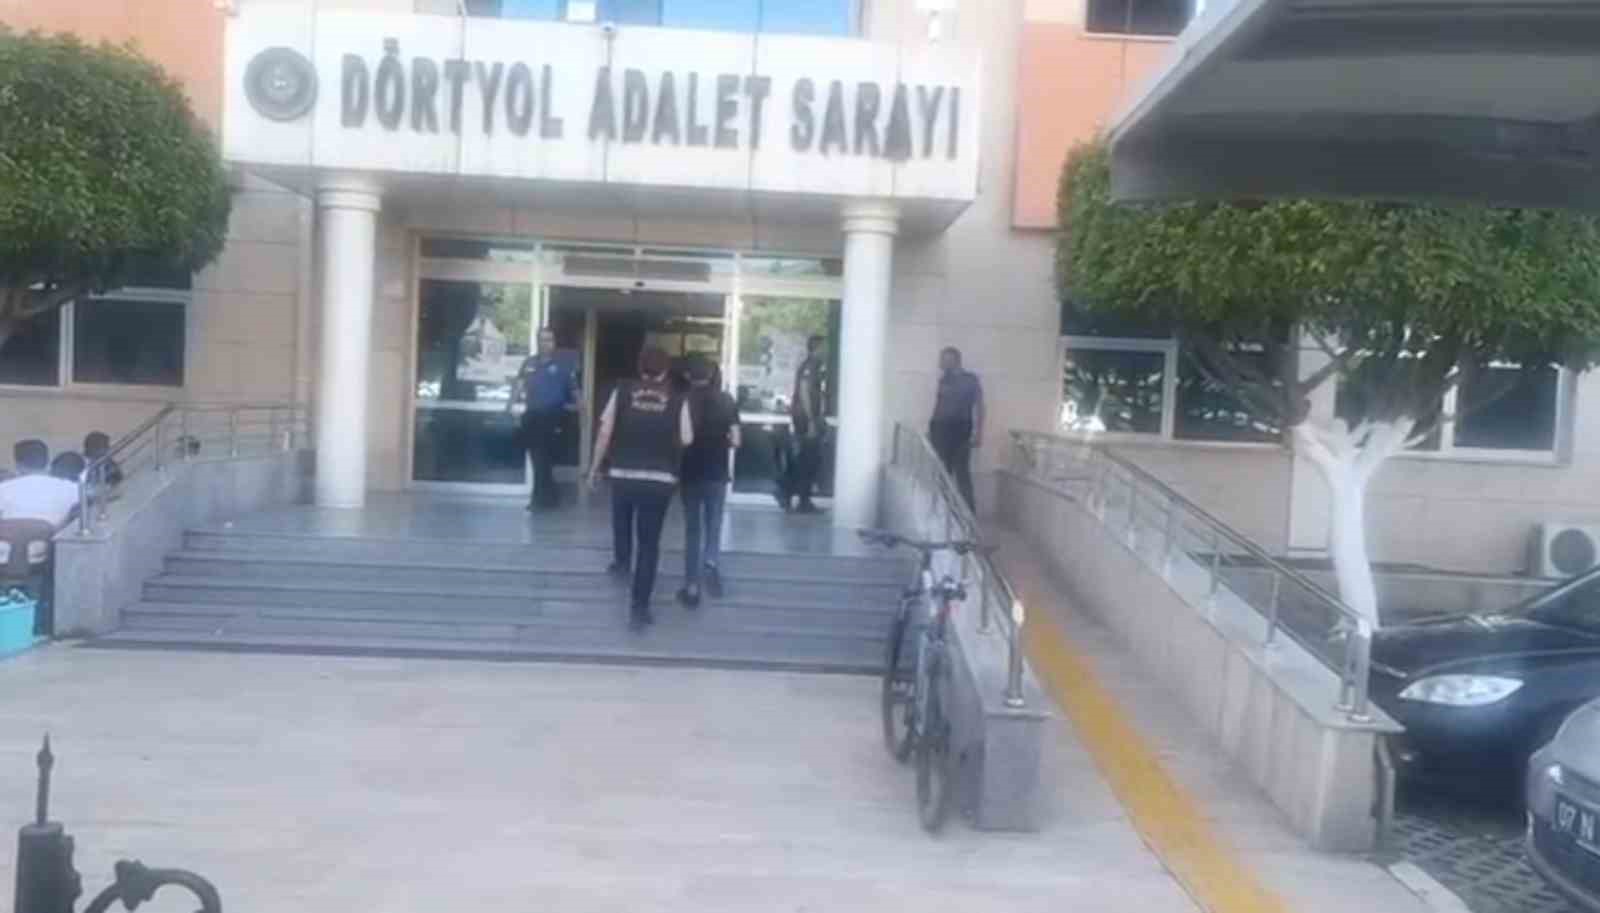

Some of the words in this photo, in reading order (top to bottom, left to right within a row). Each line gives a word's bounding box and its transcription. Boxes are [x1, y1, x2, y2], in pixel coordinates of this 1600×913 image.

[340, 37, 564, 139] DÖRTYOL
[587, 65, 772, 150] ADALET
[789, 77, 961, 162] SARAYI
